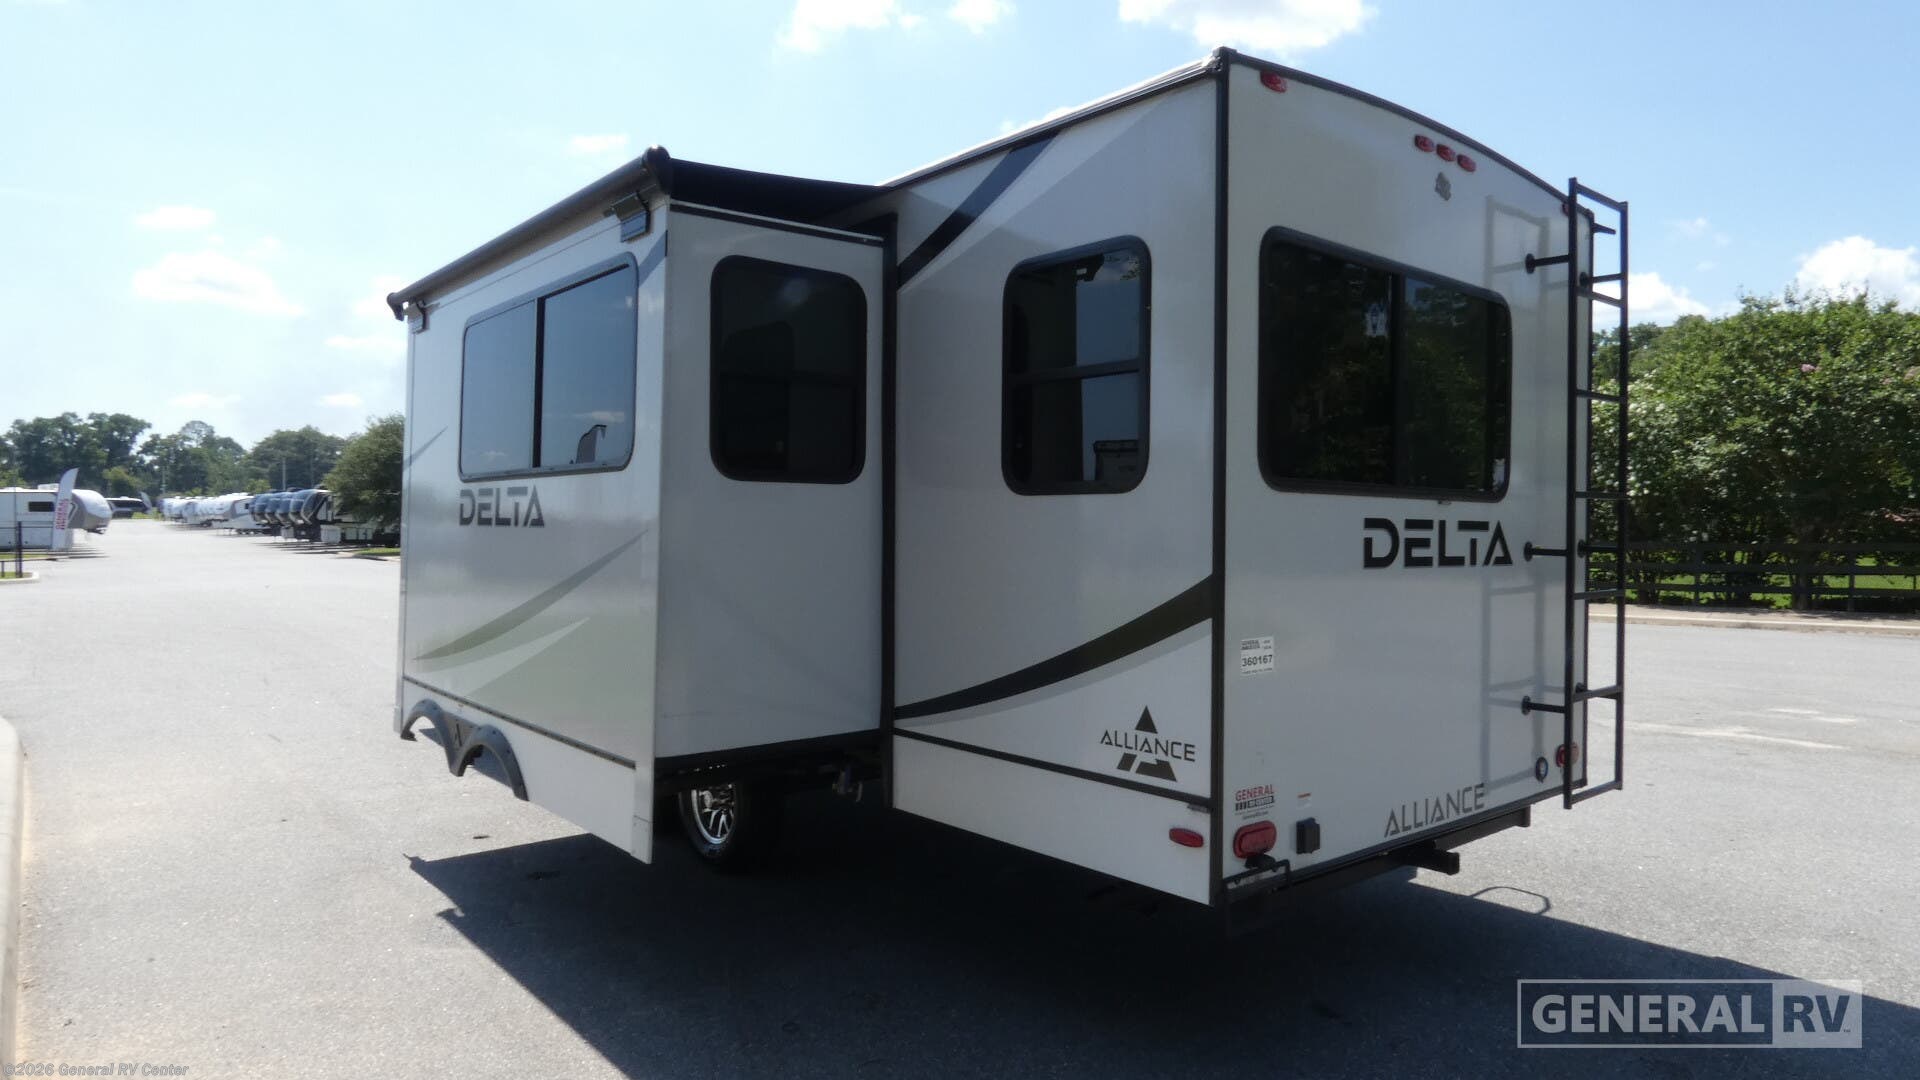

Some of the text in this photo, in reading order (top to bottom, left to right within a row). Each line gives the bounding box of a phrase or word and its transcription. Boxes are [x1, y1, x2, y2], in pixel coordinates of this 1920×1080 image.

[459, 485, 545, 527] DELTA
[1364, 518, 1513, 568] DELTA
[1241, 654, 1273, 667] 360167
[1100, 729, 1196, 762] ALLIANCE
[1235, 784, 1274, 801] GENERAL
[1384, 782, 1485, 838] ALLIANCE
